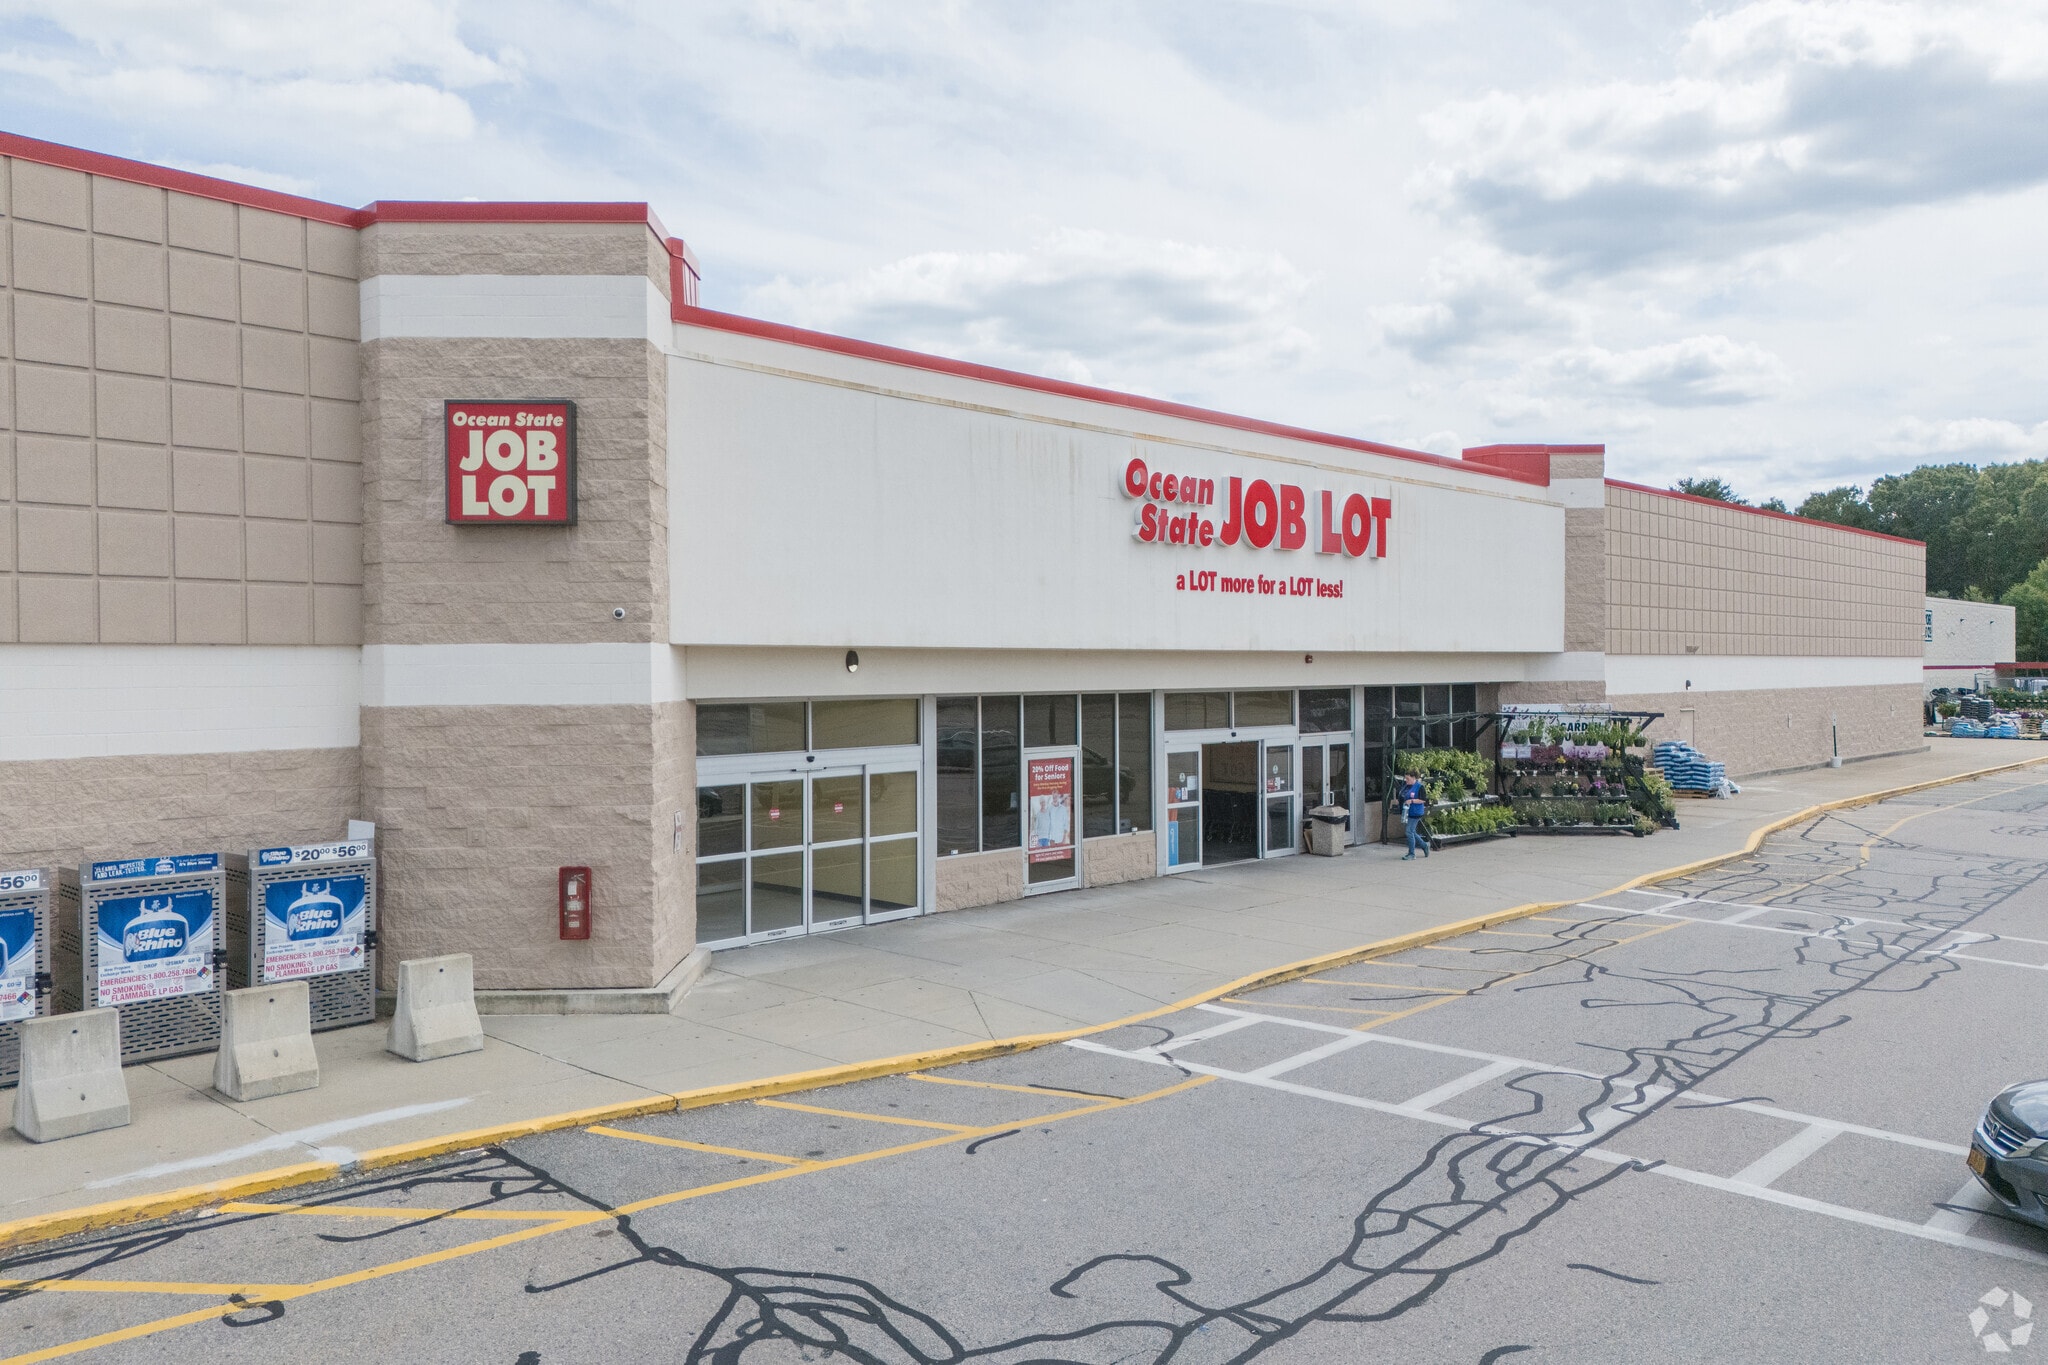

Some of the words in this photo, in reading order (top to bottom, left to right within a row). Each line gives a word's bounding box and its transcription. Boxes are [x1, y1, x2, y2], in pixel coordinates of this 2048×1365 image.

[452, 411, 511, 427] Ocean
[514, 411, 564, 427] State
[459, 429, 559, 472] JOB
[1123, 457, 1215, 505] Ocean
[461, 474, 556, 517] LOT
[1217, 475, 1307, 550] JOB
[1318, 489, 1392, 559] LOT
[1136, 502, 1214, 548] State
[1176, 575, 1185, 591] a
[1189, 570, 1217, 592] LOT
[1221, 576, 1254, 594] more
[1257, 574, 1276, 595] for
[1279, 580, 1287, 595] a
[1290, 577, 1314, 597] LOT
[1316, 578, 1344, 599] less!
[1044, 772, 1066, 780] Seniors
[300, 909, 333, 920] Blue
[296, 918, 339, 932] Rhino
[138, 927, 176, 939] Blue
[134, 938, 183, 953] Rhino
[275, 967, 315, 977] FLAMMABLE
[276, 961, 307, 971] SMOKING
[100, 989, 110, 997] NO
[112, 983, 147, 995] SMOKING
[111, 989, 157, 1002] FLAMMABLE
[159, 987, 168, 995] LP
[169, 985, 184, 993] GAS
